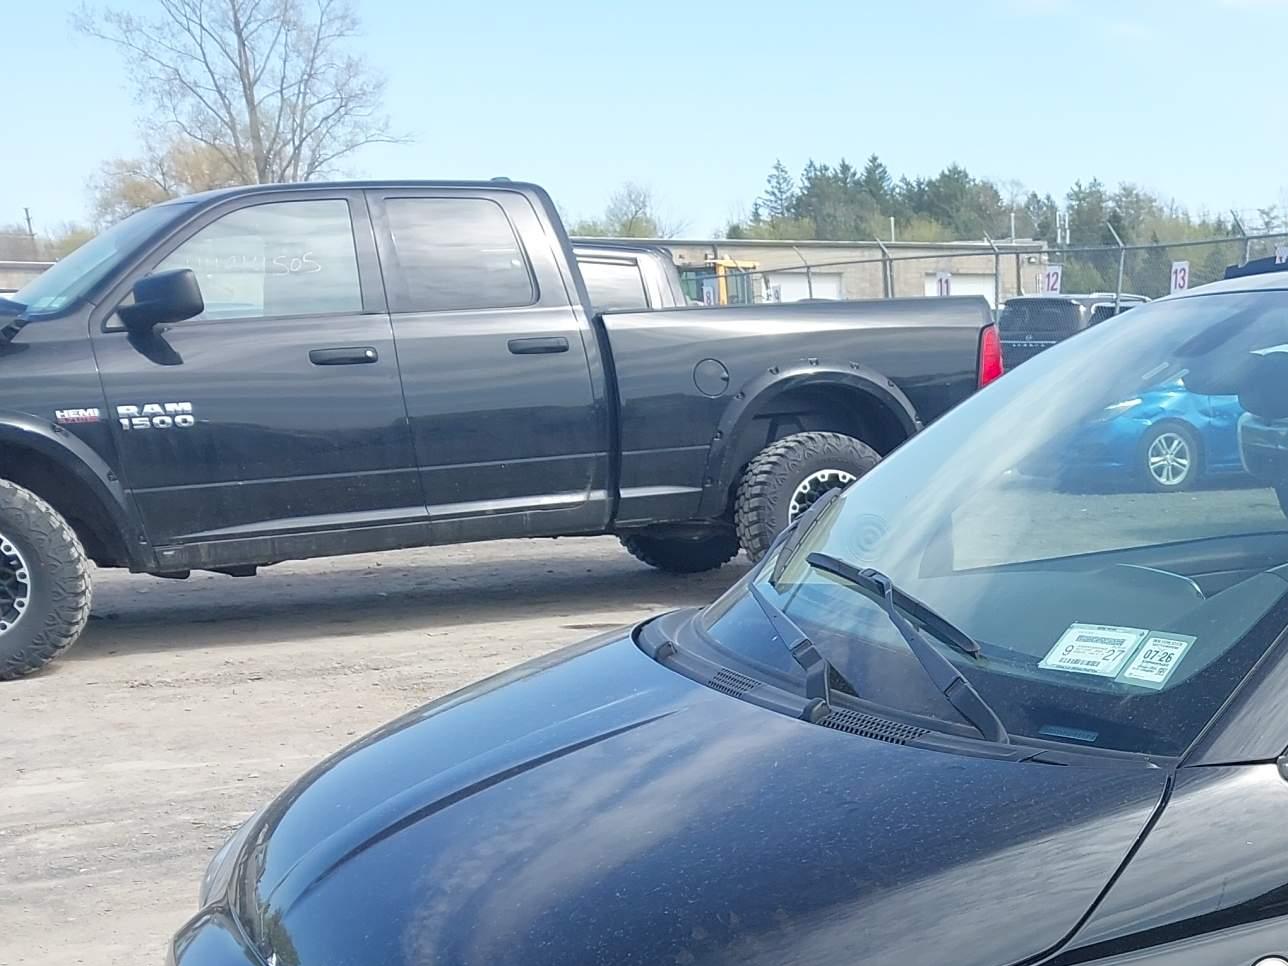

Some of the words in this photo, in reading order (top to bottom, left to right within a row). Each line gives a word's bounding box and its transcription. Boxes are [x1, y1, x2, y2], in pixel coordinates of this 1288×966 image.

[938, 278, 950, 296] 11
[1046, 271, 1059, 292] 12
[1173, 267, 1186, 289] 13
[55, 408, 99, 418] HEMI
[116, 402, 192, 417] RAM
[119, 415, 195, 431] 1500
[1062, 645, 1075, 657] 9
[1102, 649, 1126, 663] 27
